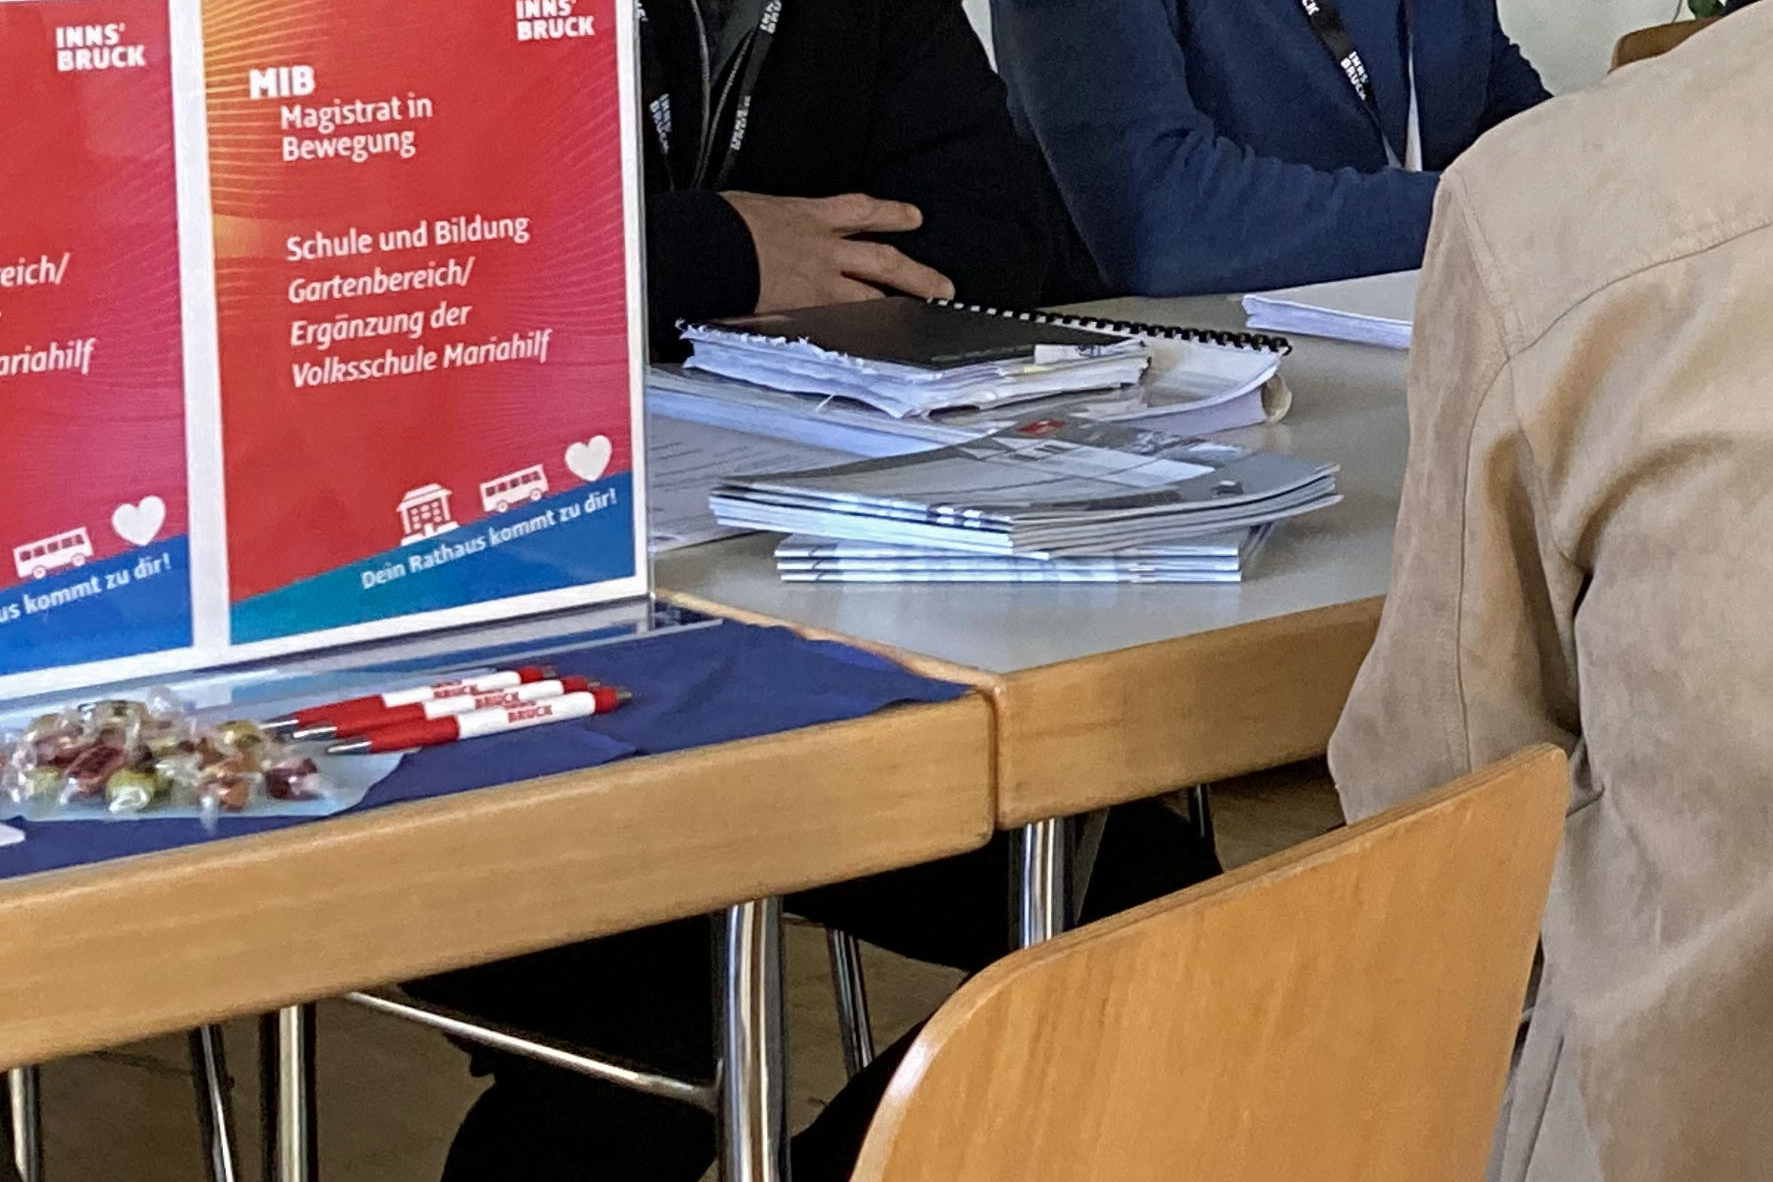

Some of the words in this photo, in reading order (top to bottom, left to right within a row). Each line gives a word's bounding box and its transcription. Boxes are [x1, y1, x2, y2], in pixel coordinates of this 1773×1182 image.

[56, 22, 126, 49] INNS'
[517, 15, 596, 41] BRUCK
[57, 44, 146, 72] BRUCK
[249, 64, 316, 100] MIB
[280, 94, 403, 134] Magistrat
[406, 90, 433, 118] in
[281, 130, 417, 163] Bewegung
[287, 227, 373, 261] Schule
[379, 220, 428, 251] und
[434, 214, 531, 245] Bildung
[0, 251, 70, 288] eich/
[287, 255, 476, 304] Gartenbereich/
[290, 309, 425, 351] Ergänzung
[430, 300, 473, 329] der
[292, 345, 438, 388] Volksschule
[442, 327, 554, 370] Mariahilf
[360, 562, 406, 590] Dein
[408, 533, 488, 574] Rathaus
[488, 509, 557, 546] kommt
[559, 500, 582, 523] zu
[583, 487, 618, 515] dir!
[22, 575, 102, 615] kommt
[104, 568, 131, 591] zu
[134, 551, 173, 581] dir!
[475, 691, 520, 710] BRUCK
[507, 704, 553, 723] BRUCK
